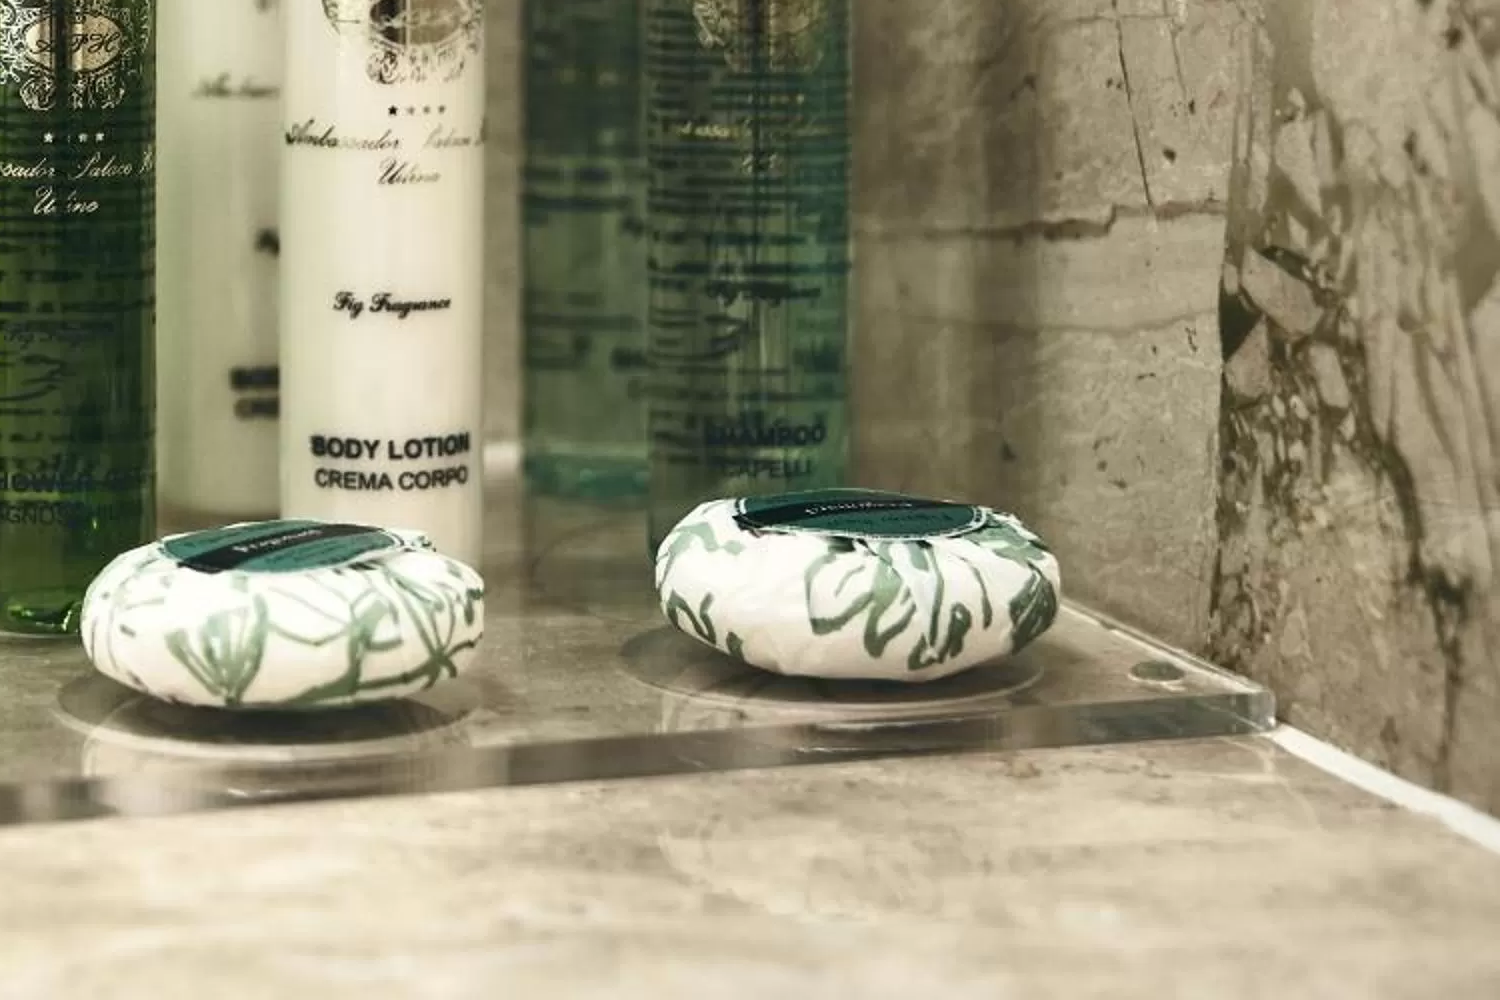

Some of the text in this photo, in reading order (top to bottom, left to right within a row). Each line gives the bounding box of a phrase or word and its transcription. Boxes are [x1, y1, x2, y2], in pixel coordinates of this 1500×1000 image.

[333, 291, 451, 320] Fig Fragrance
[310, 432, 471, 460] BODY LOTION
[314, 465, 468, 491] CREMA CORPO
